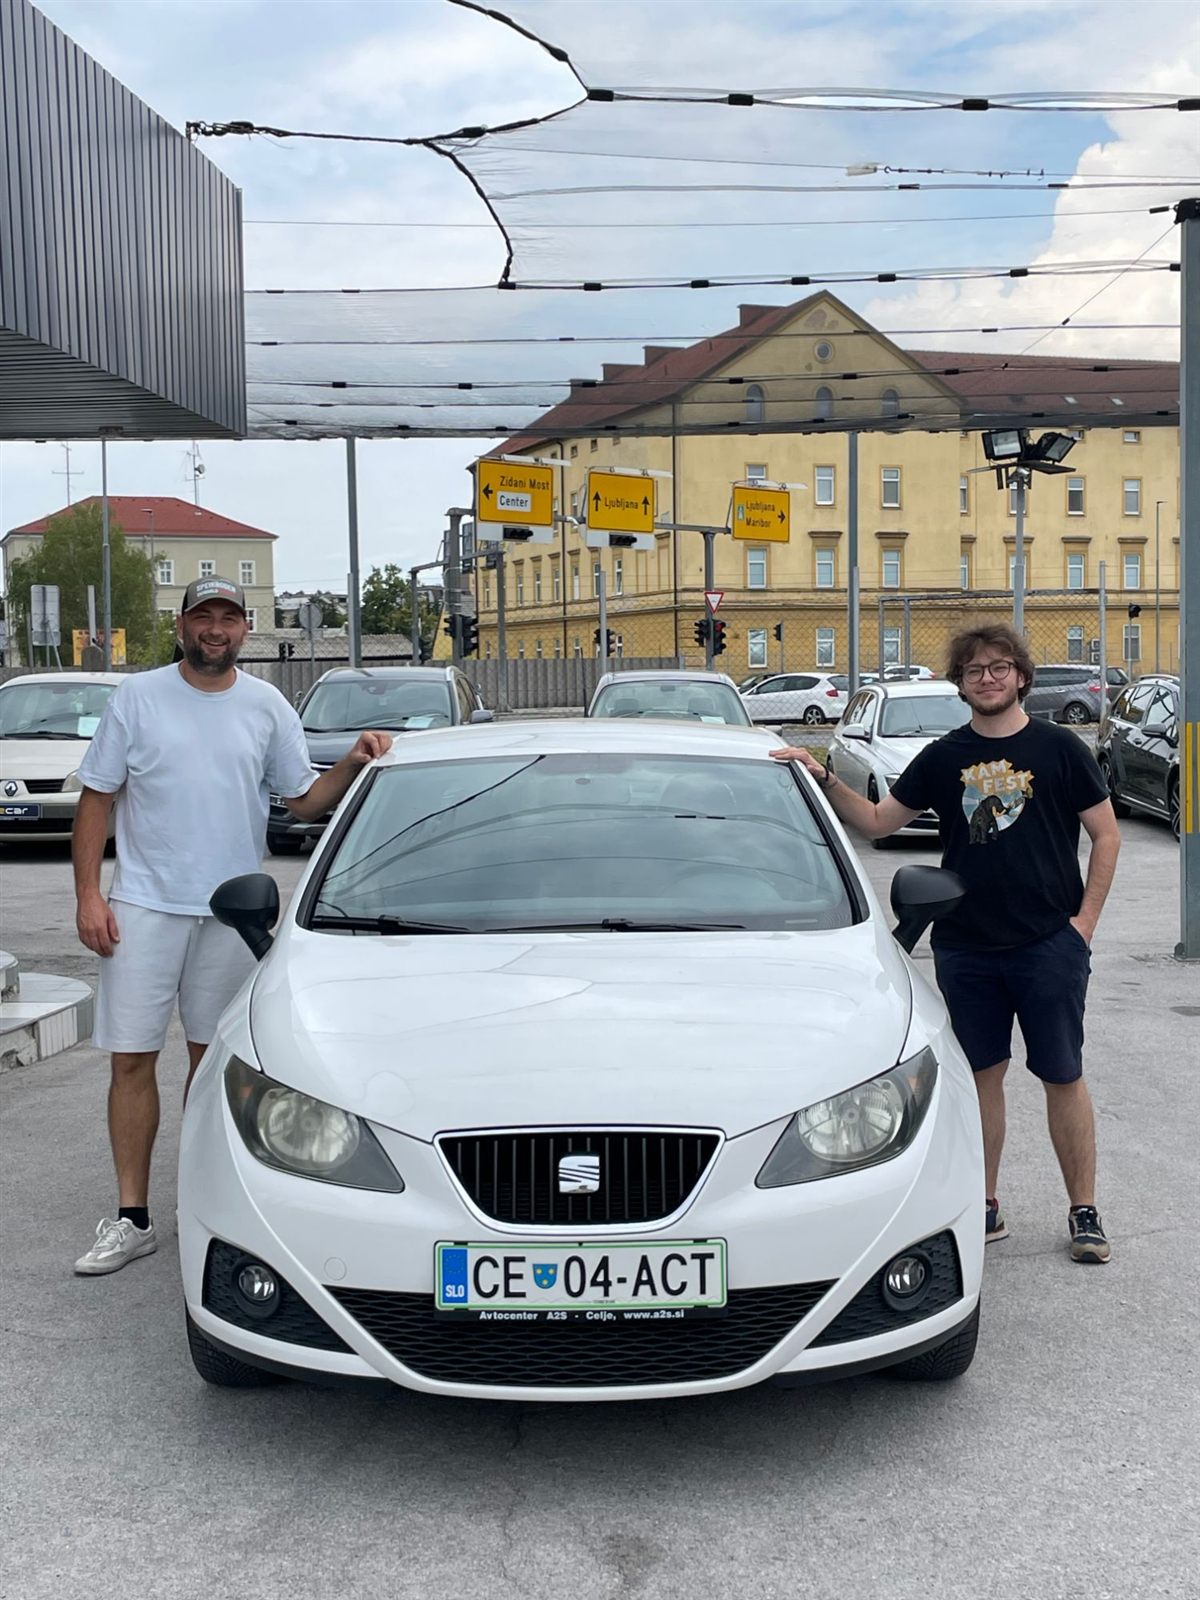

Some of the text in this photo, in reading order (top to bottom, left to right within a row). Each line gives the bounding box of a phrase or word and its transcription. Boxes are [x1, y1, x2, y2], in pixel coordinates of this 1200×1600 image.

[500, 476, 550, 490] Zidani Most
[499, 495, 528, 507] Center
[604, 497, 639, 511] Ljubljana
[746, 500, 775, 512] Ljubljana
[746, 517, 771, 528] Maribor
[963, 761, 1007, 781] KAM
[982, 773, 1028, 794] FEST
[473, 1253, 715, 1298] CE 04-ACT
[445, 1285, 465, 1298] SLO
[479, 1311, 538, 1320] Avtocenter
[546, 1311, 567, 1320] A2S
[586, 1311, 617, 1321] Celje,
[624, 1310, 684, 1320] www.a2s.si
